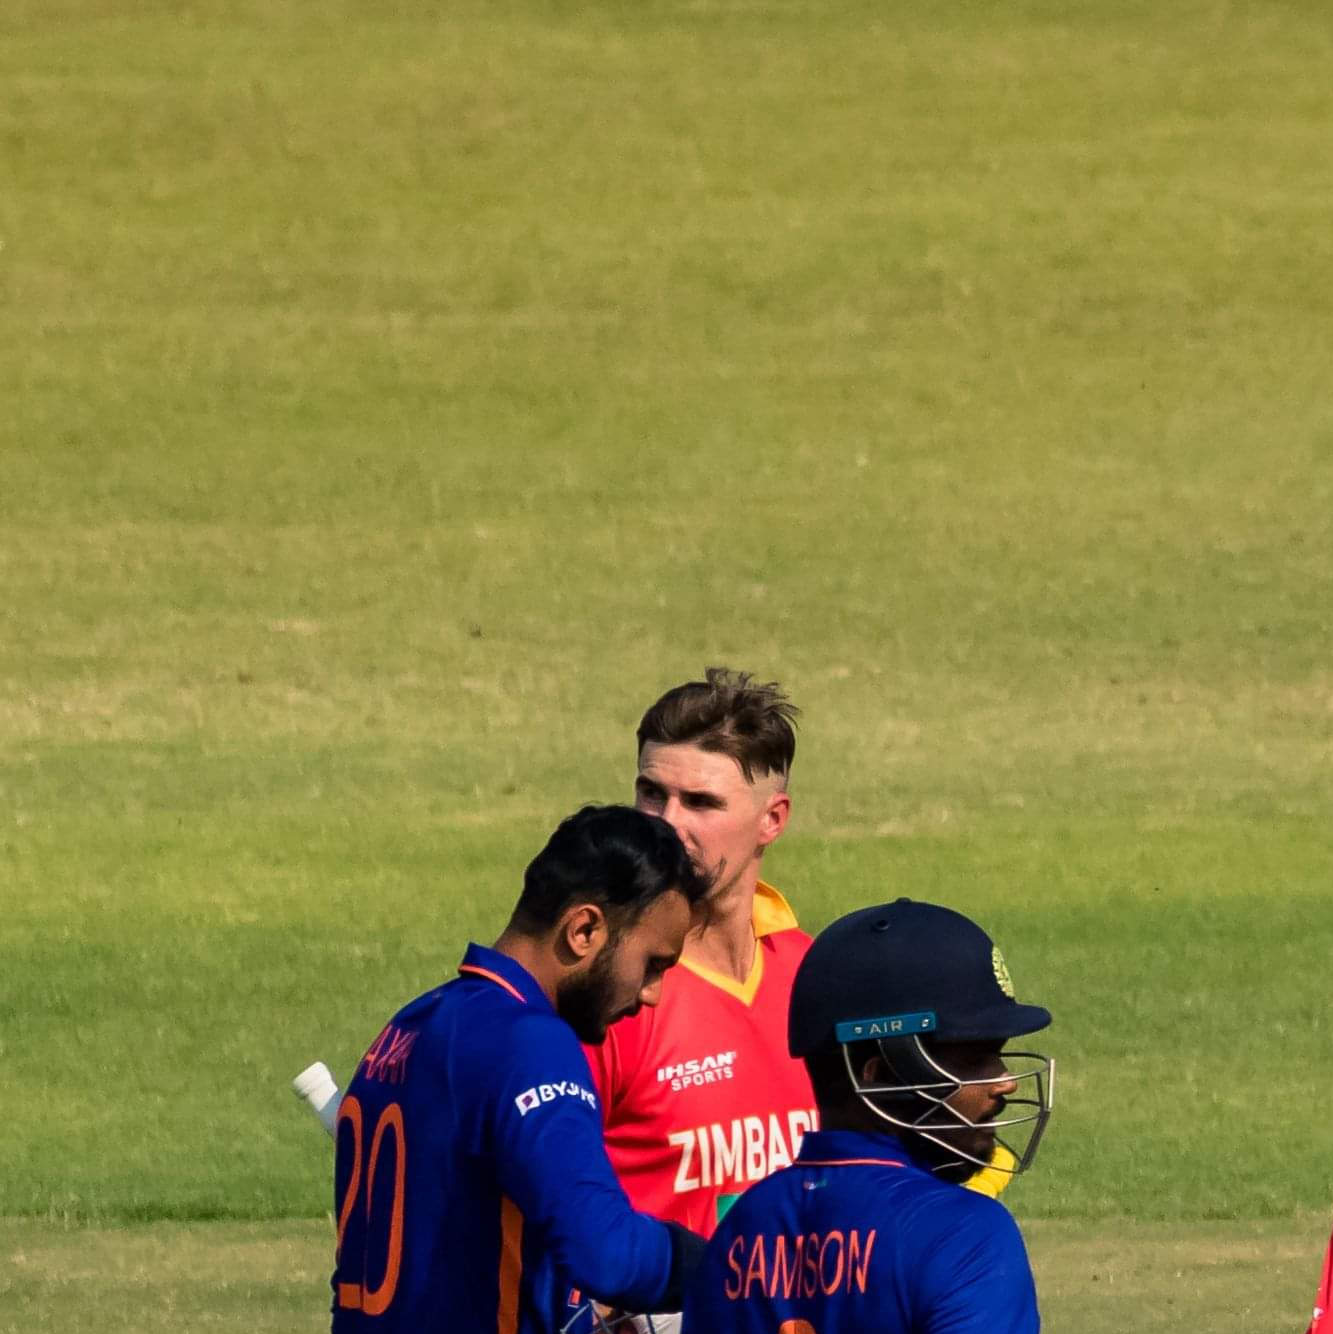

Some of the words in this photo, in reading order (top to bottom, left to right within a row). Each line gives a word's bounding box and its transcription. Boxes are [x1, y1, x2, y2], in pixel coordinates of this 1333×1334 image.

[870, 1020, 903, 1035] AIR
[657, 1052, 734, 1082] IHSAN
[671, 1066, 734, 1092] SPORTS
[335, 1095, 406, 1316] 20
[725, 1230, 877, 1300] SAMSON
